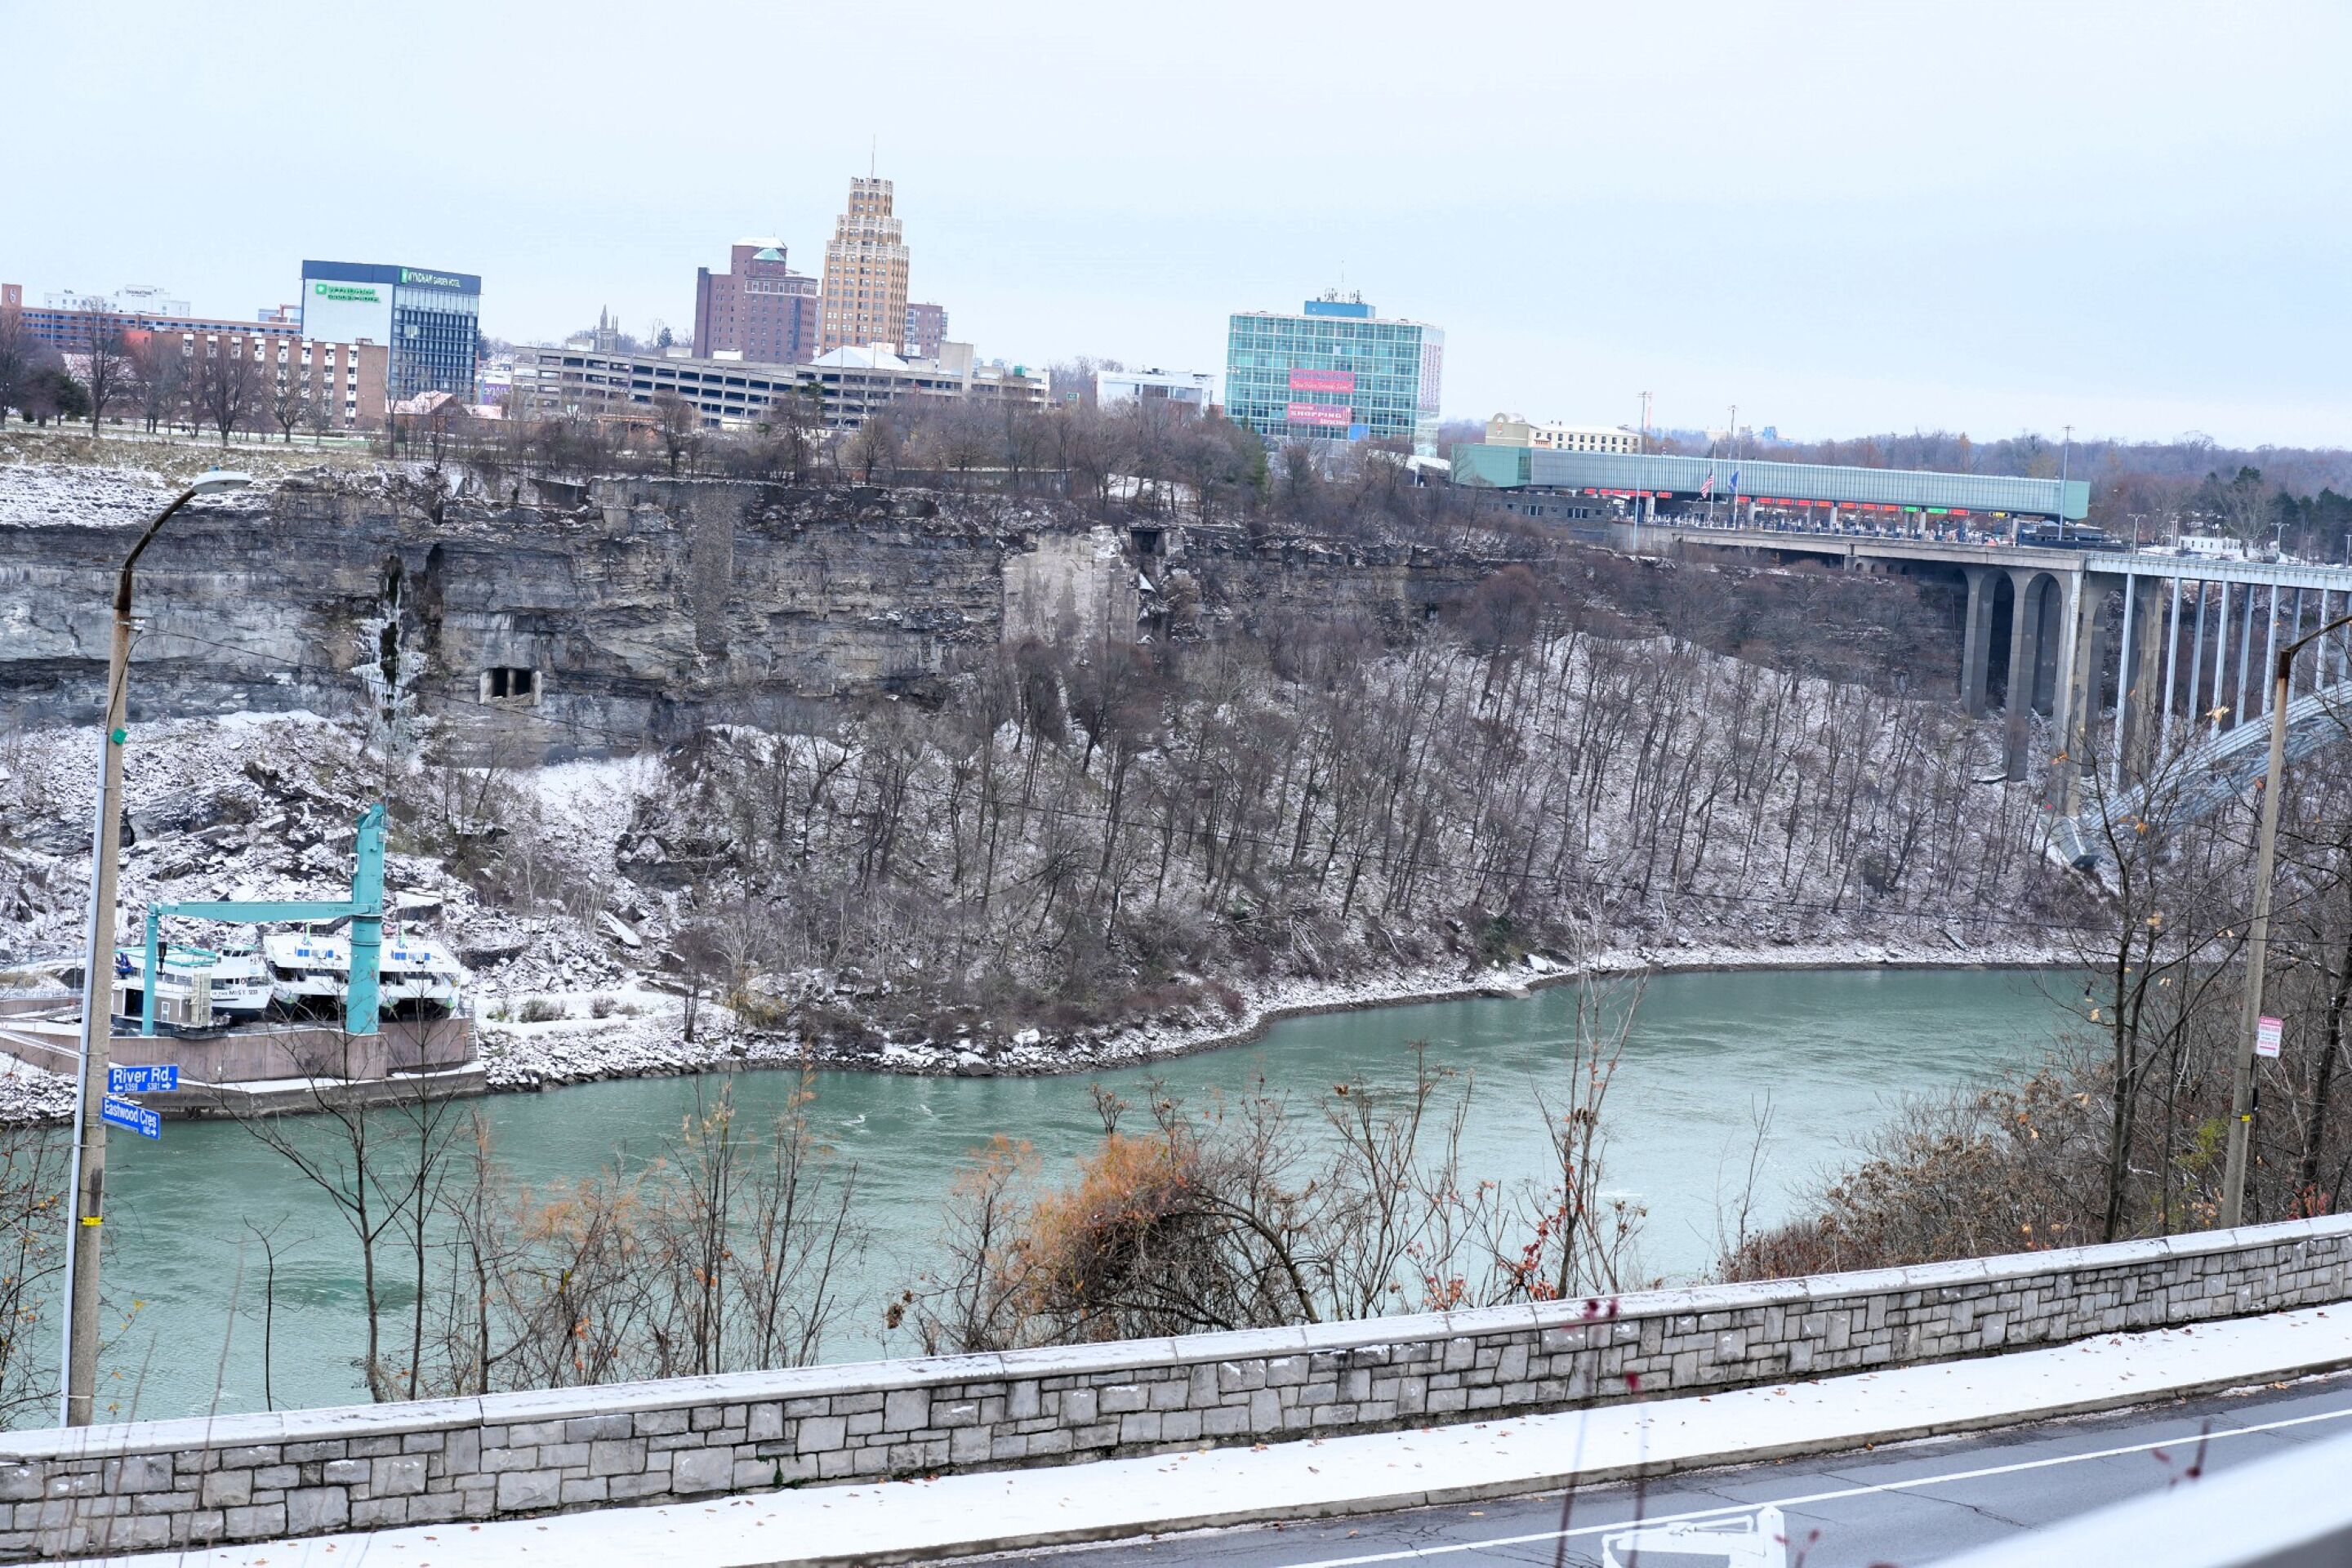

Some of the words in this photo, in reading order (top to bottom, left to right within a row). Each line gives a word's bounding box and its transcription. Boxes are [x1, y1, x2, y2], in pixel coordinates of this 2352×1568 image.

[113, 1068, 148, 1084] River
[151, 1066, 172, 1082] Rd.
[105, 1099, 138, 1122] Eastwood
[140, 1110, 157, 1128] Cres
